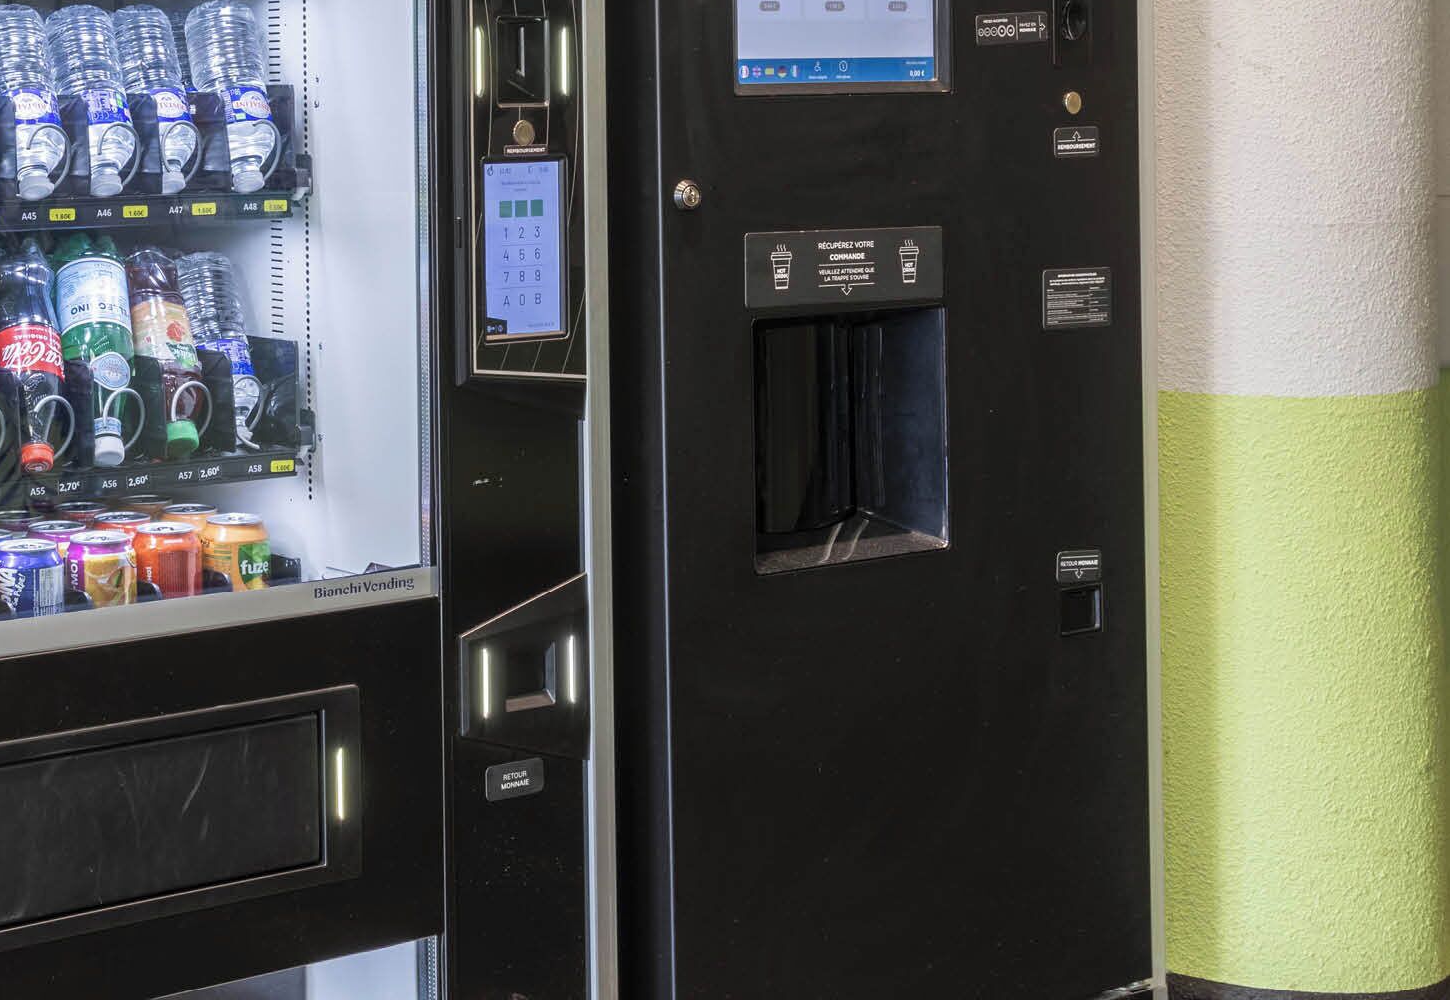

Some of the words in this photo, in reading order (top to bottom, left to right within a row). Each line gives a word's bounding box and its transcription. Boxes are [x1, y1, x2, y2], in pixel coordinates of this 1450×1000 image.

[169, 205, 183, 215] A47
[243, 202, 258, 211] A48
[21, 212, 37, 221] A45
[97, 208, 112, 217] A46
[518, 226, 525, 239] 2
[534, 226, 541, 238] 3
[817, 240, 854, 250] RÉCUPÉREZ
[854, 240, 875, 248] VOTRE
[503, 249, 510, 261] 4
[518, 248, 525, 260] 5
[534, 247, 541, 260] 6
[829, 252, 865, 261] COMMANDE
[503, 271, 510, 283] 7
[519, 270, 525, 282] 8
[534, 269, 541, 281] 9
[503, 295, 510, 307] A
[247, 463, 263, 473] A58
[178, 470, 193, 480] A57
[102, 478, 118, 489] A56
[30, 486, 46, 496] A55
[240, 558, 269, 578] fuze
[314, 582, 362, 599] Bianchi
[363, 576, 415, 594] Vending
[502, 770, 527, 781] RETOUR
[500, 778, 530, 790] MONNAIE
